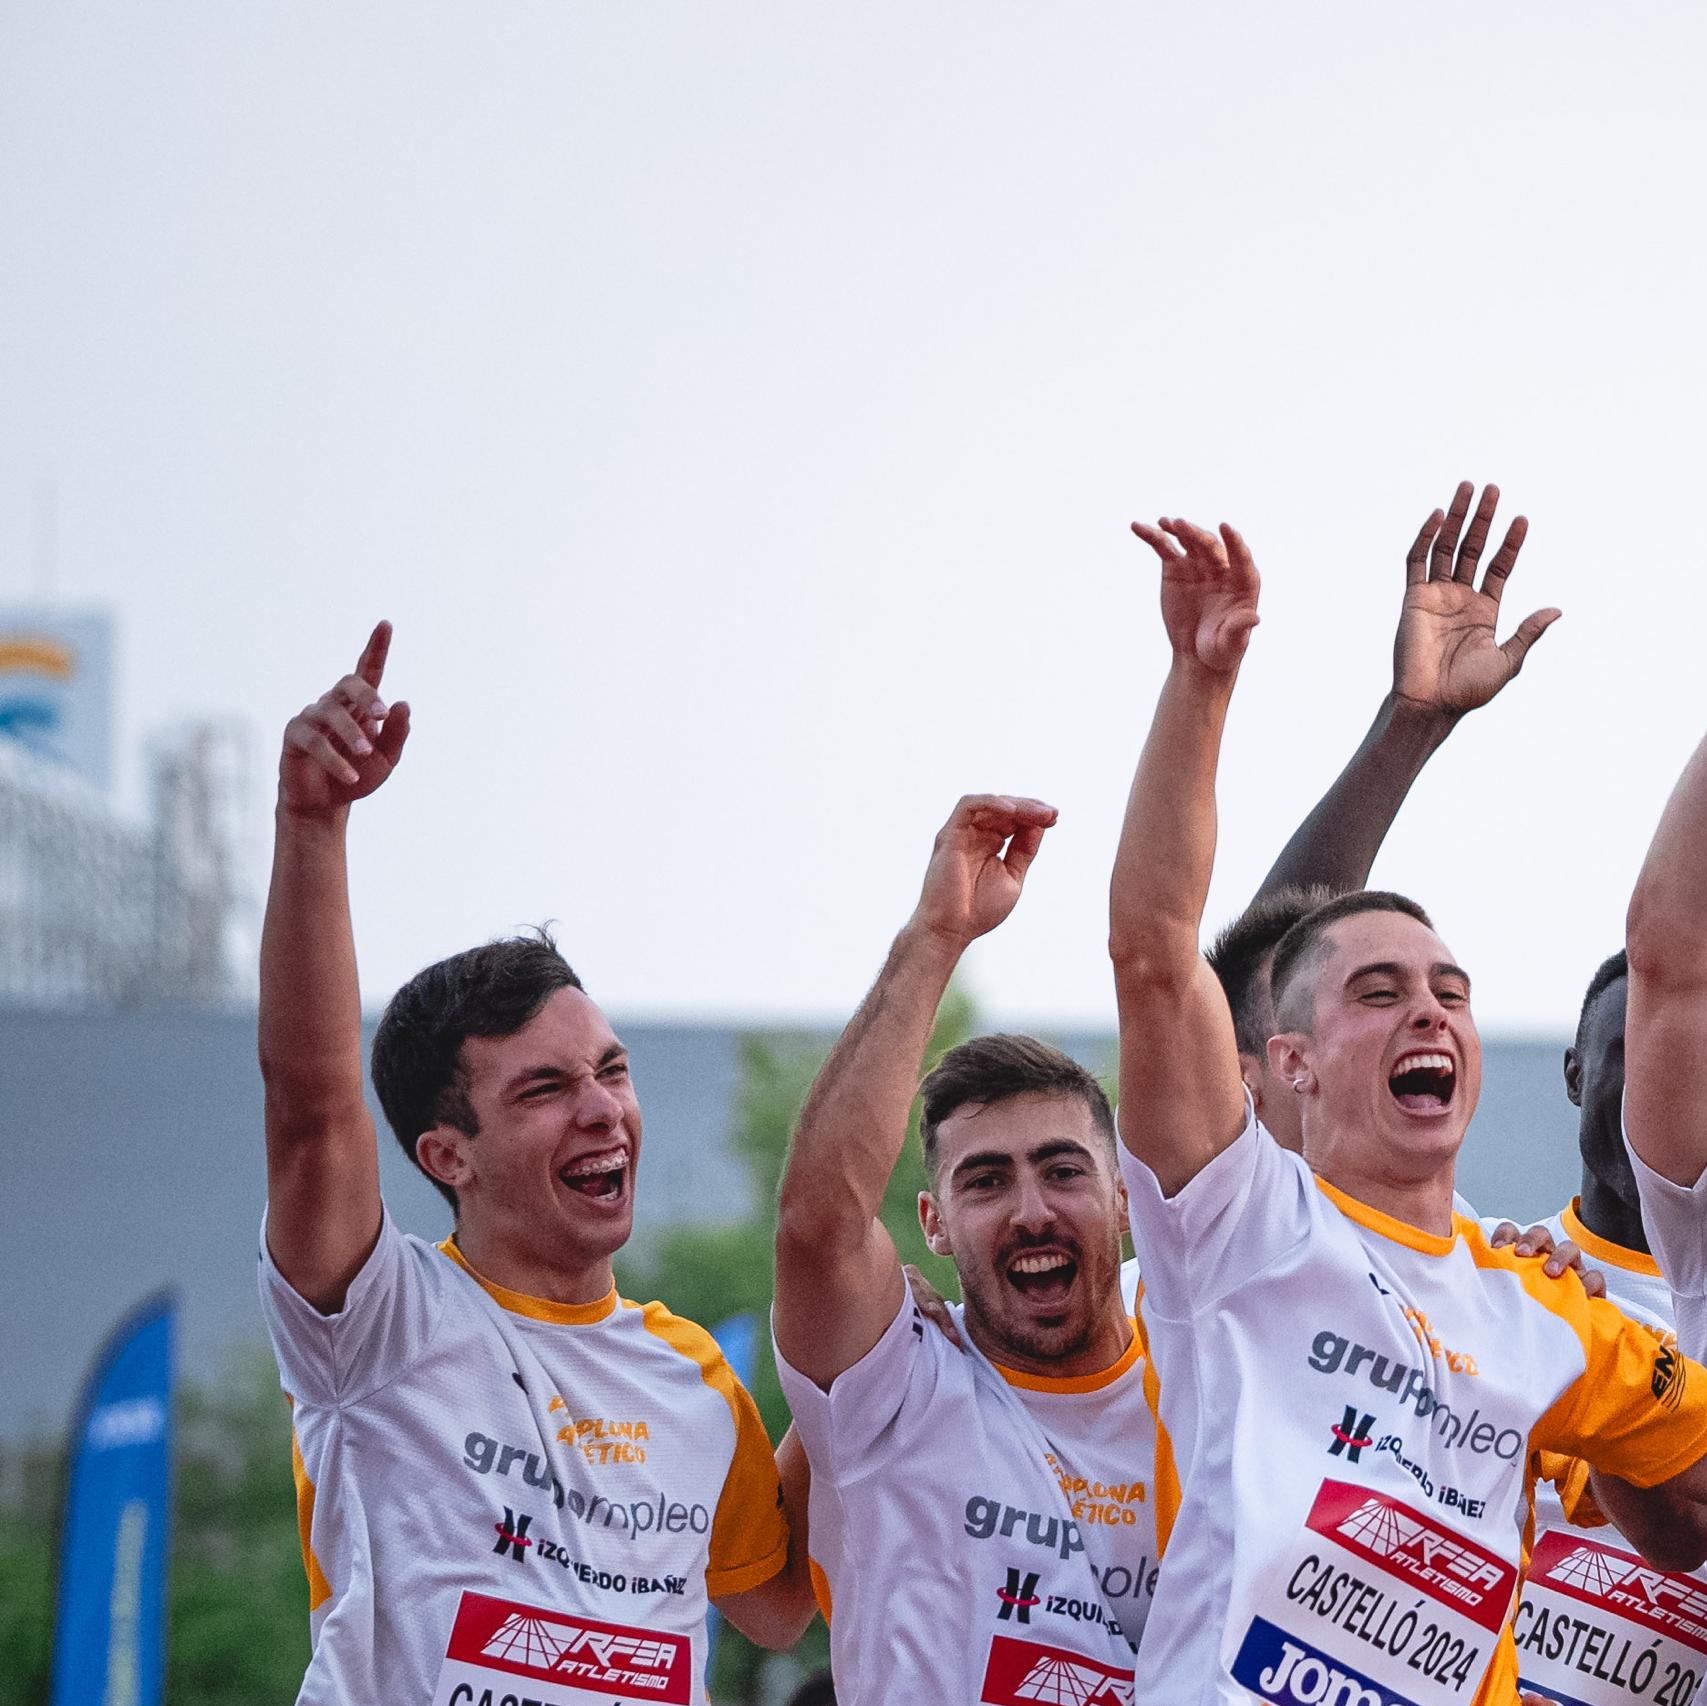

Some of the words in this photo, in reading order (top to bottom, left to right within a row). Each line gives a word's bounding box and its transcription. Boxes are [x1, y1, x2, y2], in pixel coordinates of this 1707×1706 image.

[463, 1431, 709, 1541] grumpleo
[1389, 1551, 1484, 1608] ATLETISMO
[1413, 1526, 1505, 1591] RFEA
[566, 1630, 677, 1670] RFEA
[1286, 1554, 1420, 1658] CASTELLÓ
[1412, 1617, 1480, 1693] 2024
[1513, 1601, 1663, 1695] CASTELLÓ
[557, 1660, 669, 1691] ATLETISMO
